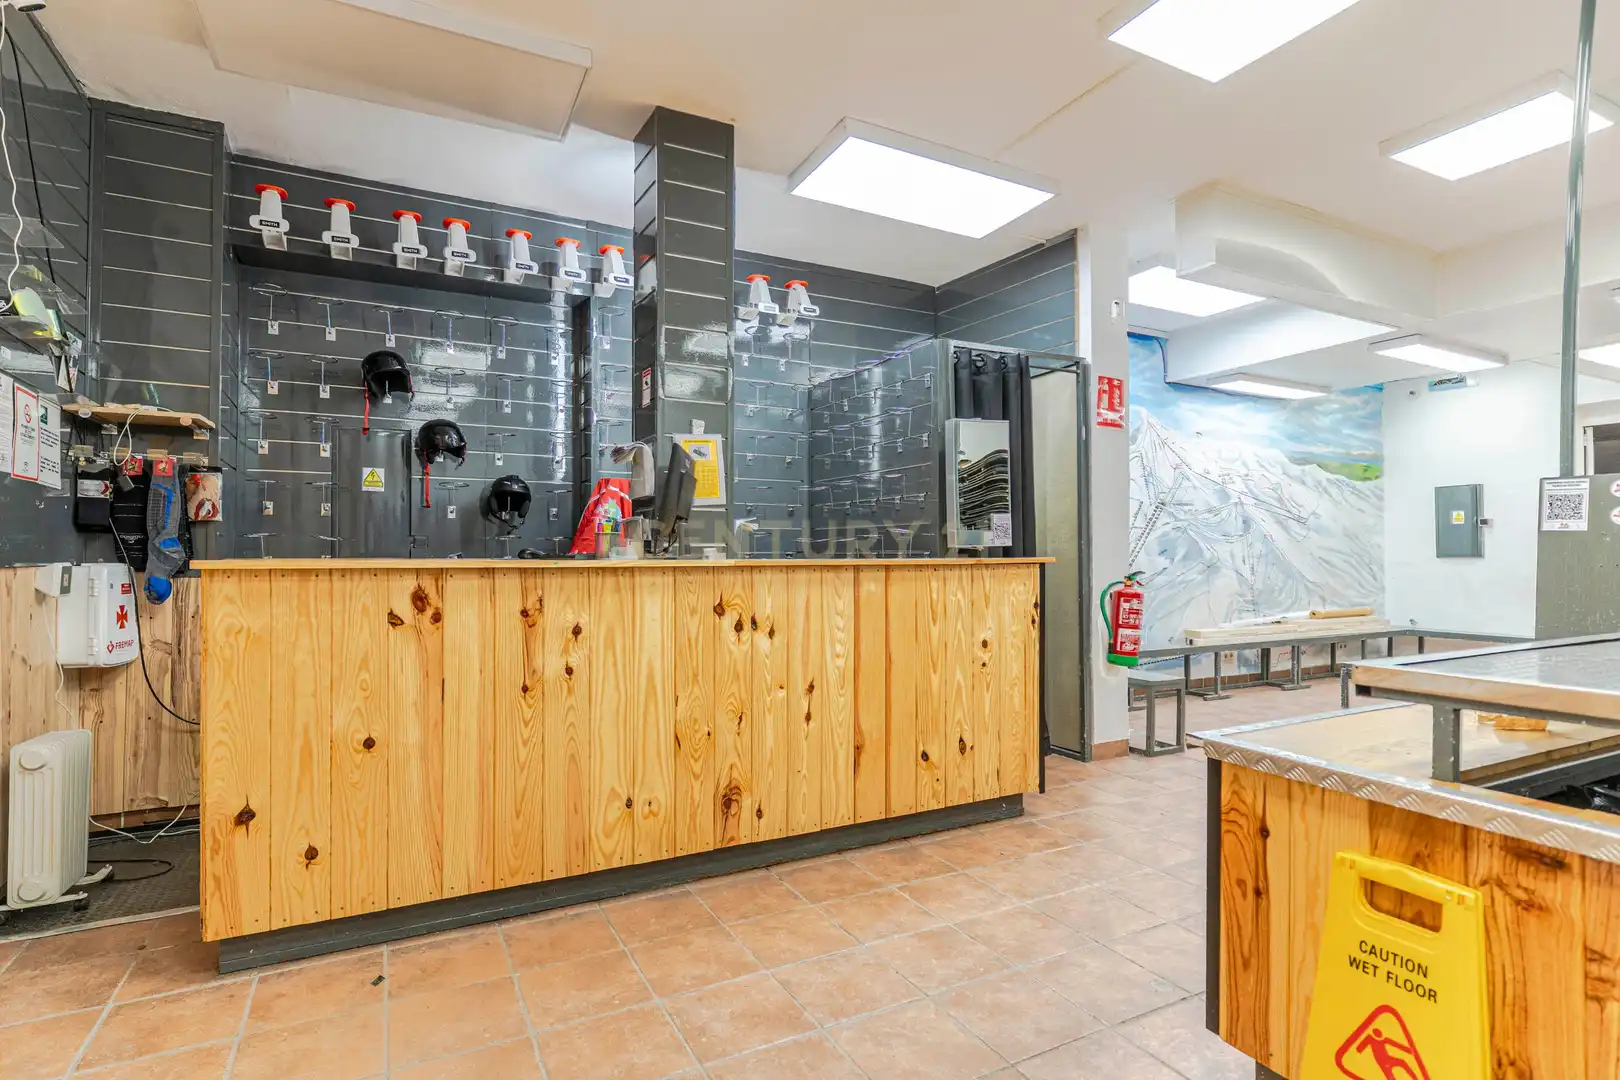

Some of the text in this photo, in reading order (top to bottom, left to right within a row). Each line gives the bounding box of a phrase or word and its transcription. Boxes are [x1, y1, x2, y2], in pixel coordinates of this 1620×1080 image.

[261, 220, 278, 228] SMITH
[115, 640, 135, 650] FREMAP
[1359, 940, 1428, 979] CAUTION
[1348, 955, 1437, 1004] WET FLOOR
